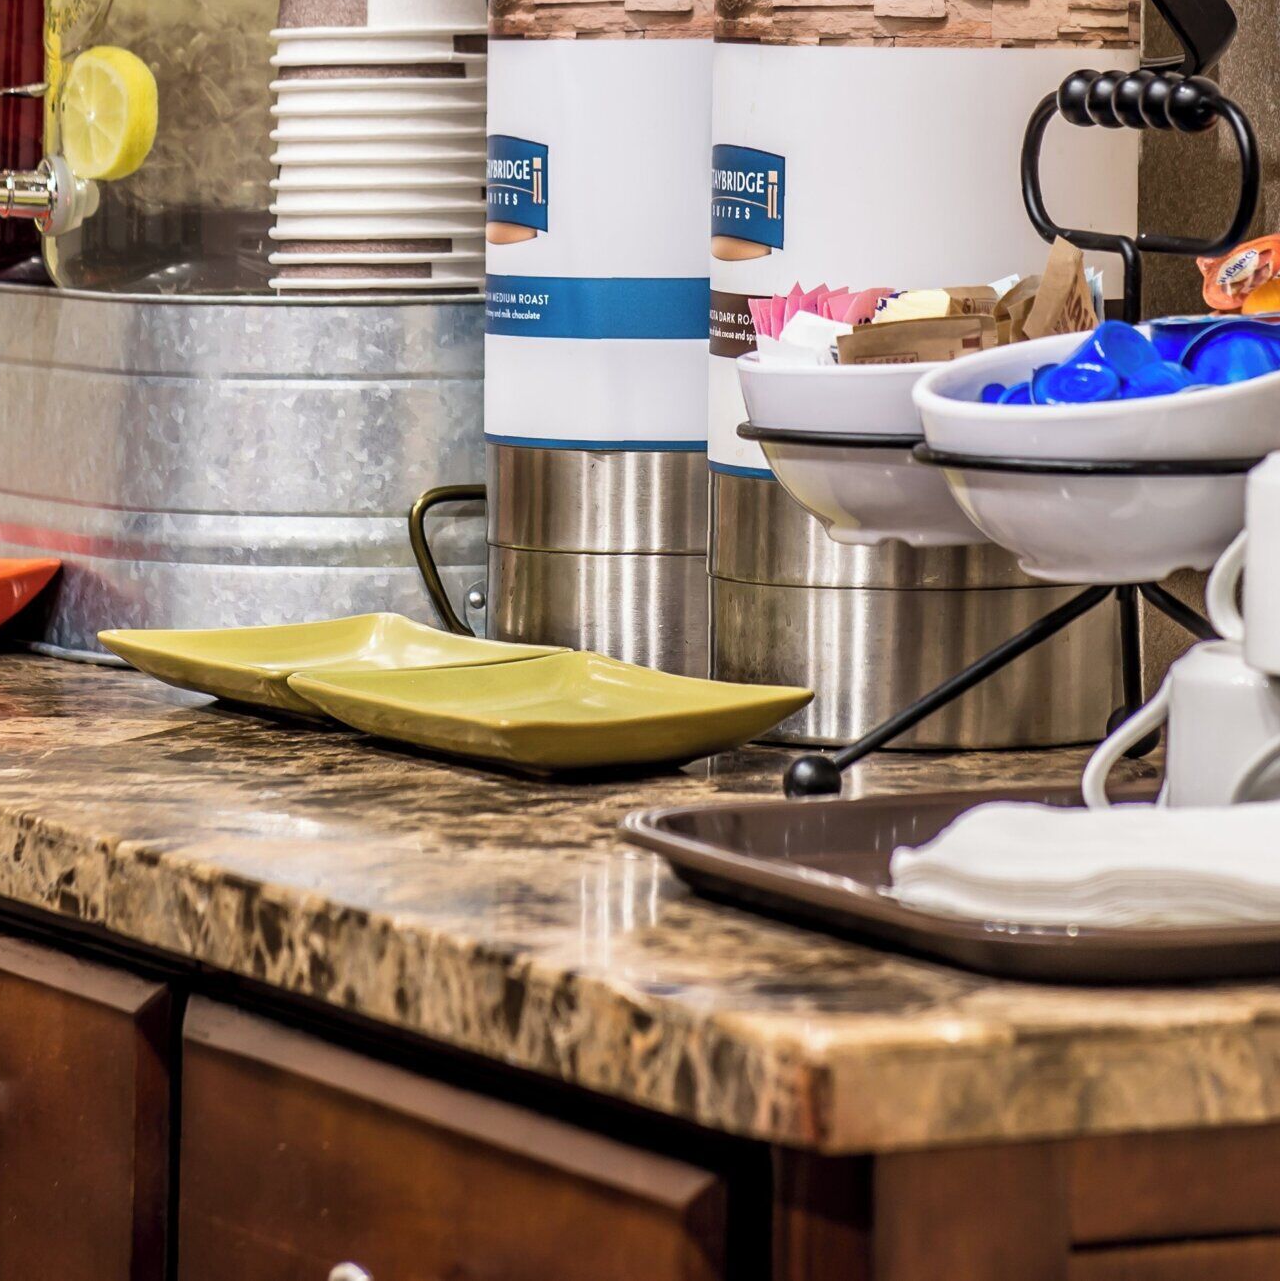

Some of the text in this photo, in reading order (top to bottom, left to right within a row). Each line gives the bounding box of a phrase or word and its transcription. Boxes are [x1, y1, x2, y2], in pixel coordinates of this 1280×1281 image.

[712, 169, 765, 194] TAYBRIDGE
[518, 293, 550, 306] ROAST
[511, 309, 541, 320] chocolate
[718, 311, 736, 324] DARK
[735, 329, 746, 341] and
